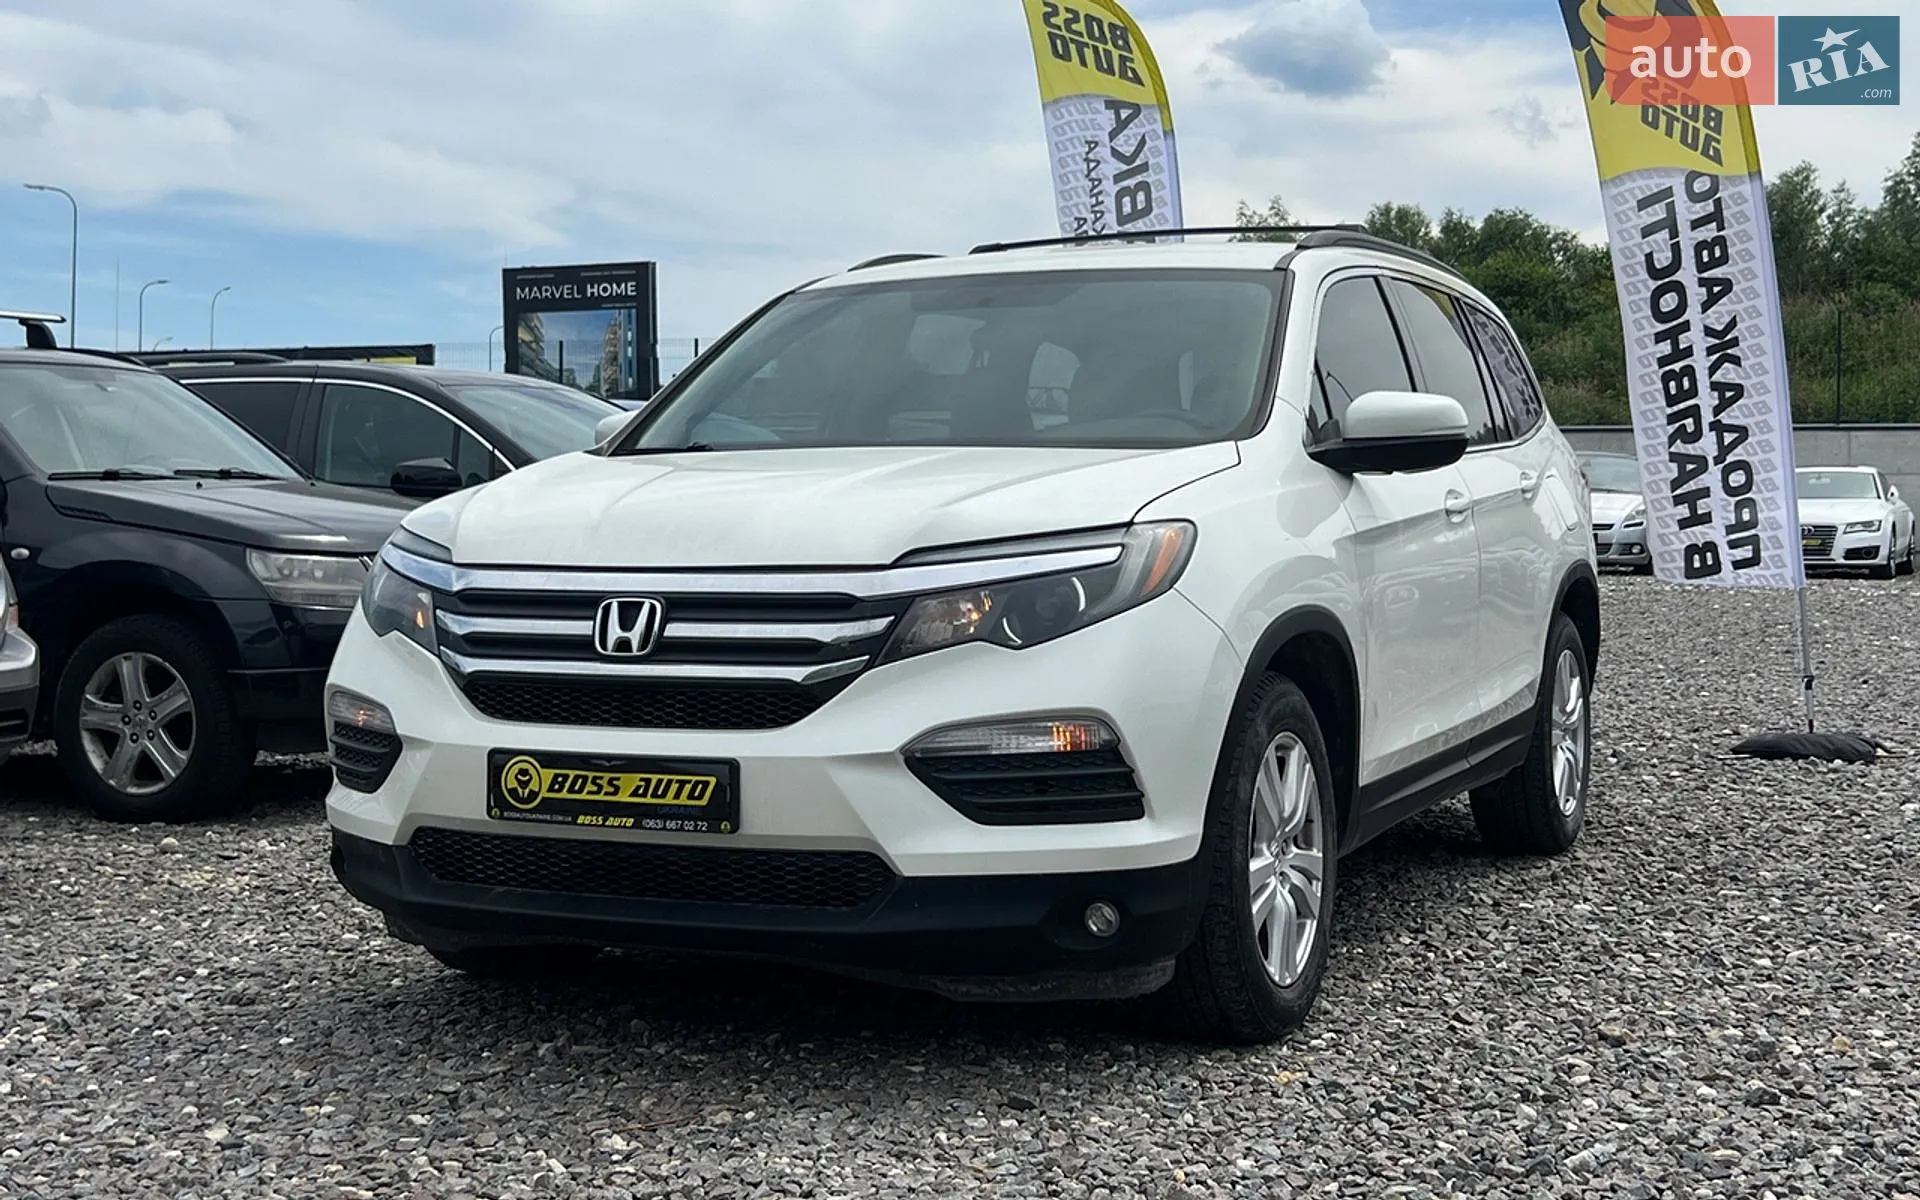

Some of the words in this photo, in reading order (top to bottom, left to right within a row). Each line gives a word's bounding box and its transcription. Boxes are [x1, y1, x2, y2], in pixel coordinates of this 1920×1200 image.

[516, 285, 582, 300] MARVEL
[587, 281, 637, 297] HOME
[546, 772, 621, 796] BOSS
[629, 776, 711, 801] AUTO
[576, 814, 603, 825] BOSS
[605, 817, 634, 827] AUTO
[683, 820, 695, 831] 02
[696, 821, 708, 831] 72
